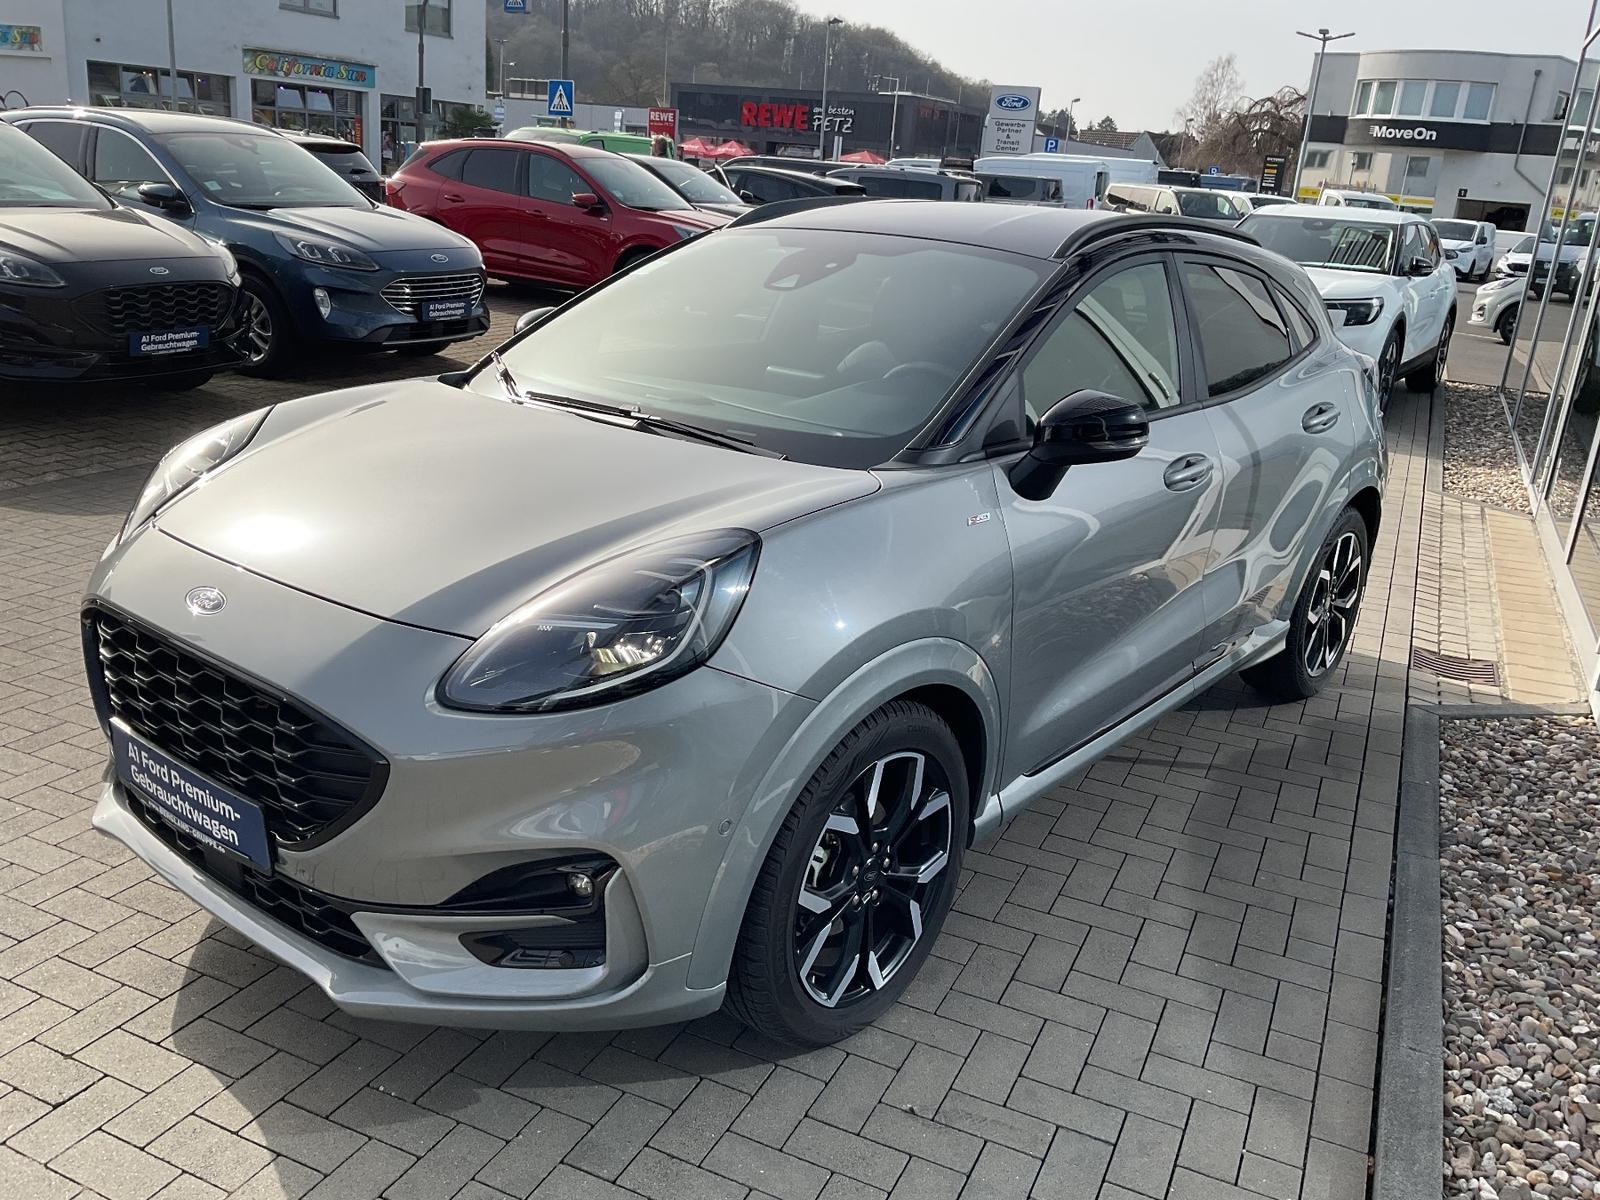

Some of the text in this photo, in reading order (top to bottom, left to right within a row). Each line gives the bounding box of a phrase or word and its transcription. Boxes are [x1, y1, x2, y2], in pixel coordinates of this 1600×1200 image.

[255, 54, 366, 82] California Sun
[1001, 96, 1024, 108] Ford
[741, 101, 809, 131] REWE
[828, 105, 855, 115] besten
[650, 111, 674, 122] REWE
[812, 115, 853, 133] PETZ
[995, 120, 1026, 128] Gewerbe
[1371, 125, 1437, 140] MoveOn
[995, 144, 1020, 152] Center
[151, 333, 167, 342] Ford
[168, 331, 200, 340] Premium-
[141, 339, 198, 351] Gebrauchtwagen
[128, 742, 241, 822] A1 Ford Premium-
[131, 764, 239, 846] Gebrauchtwagen
